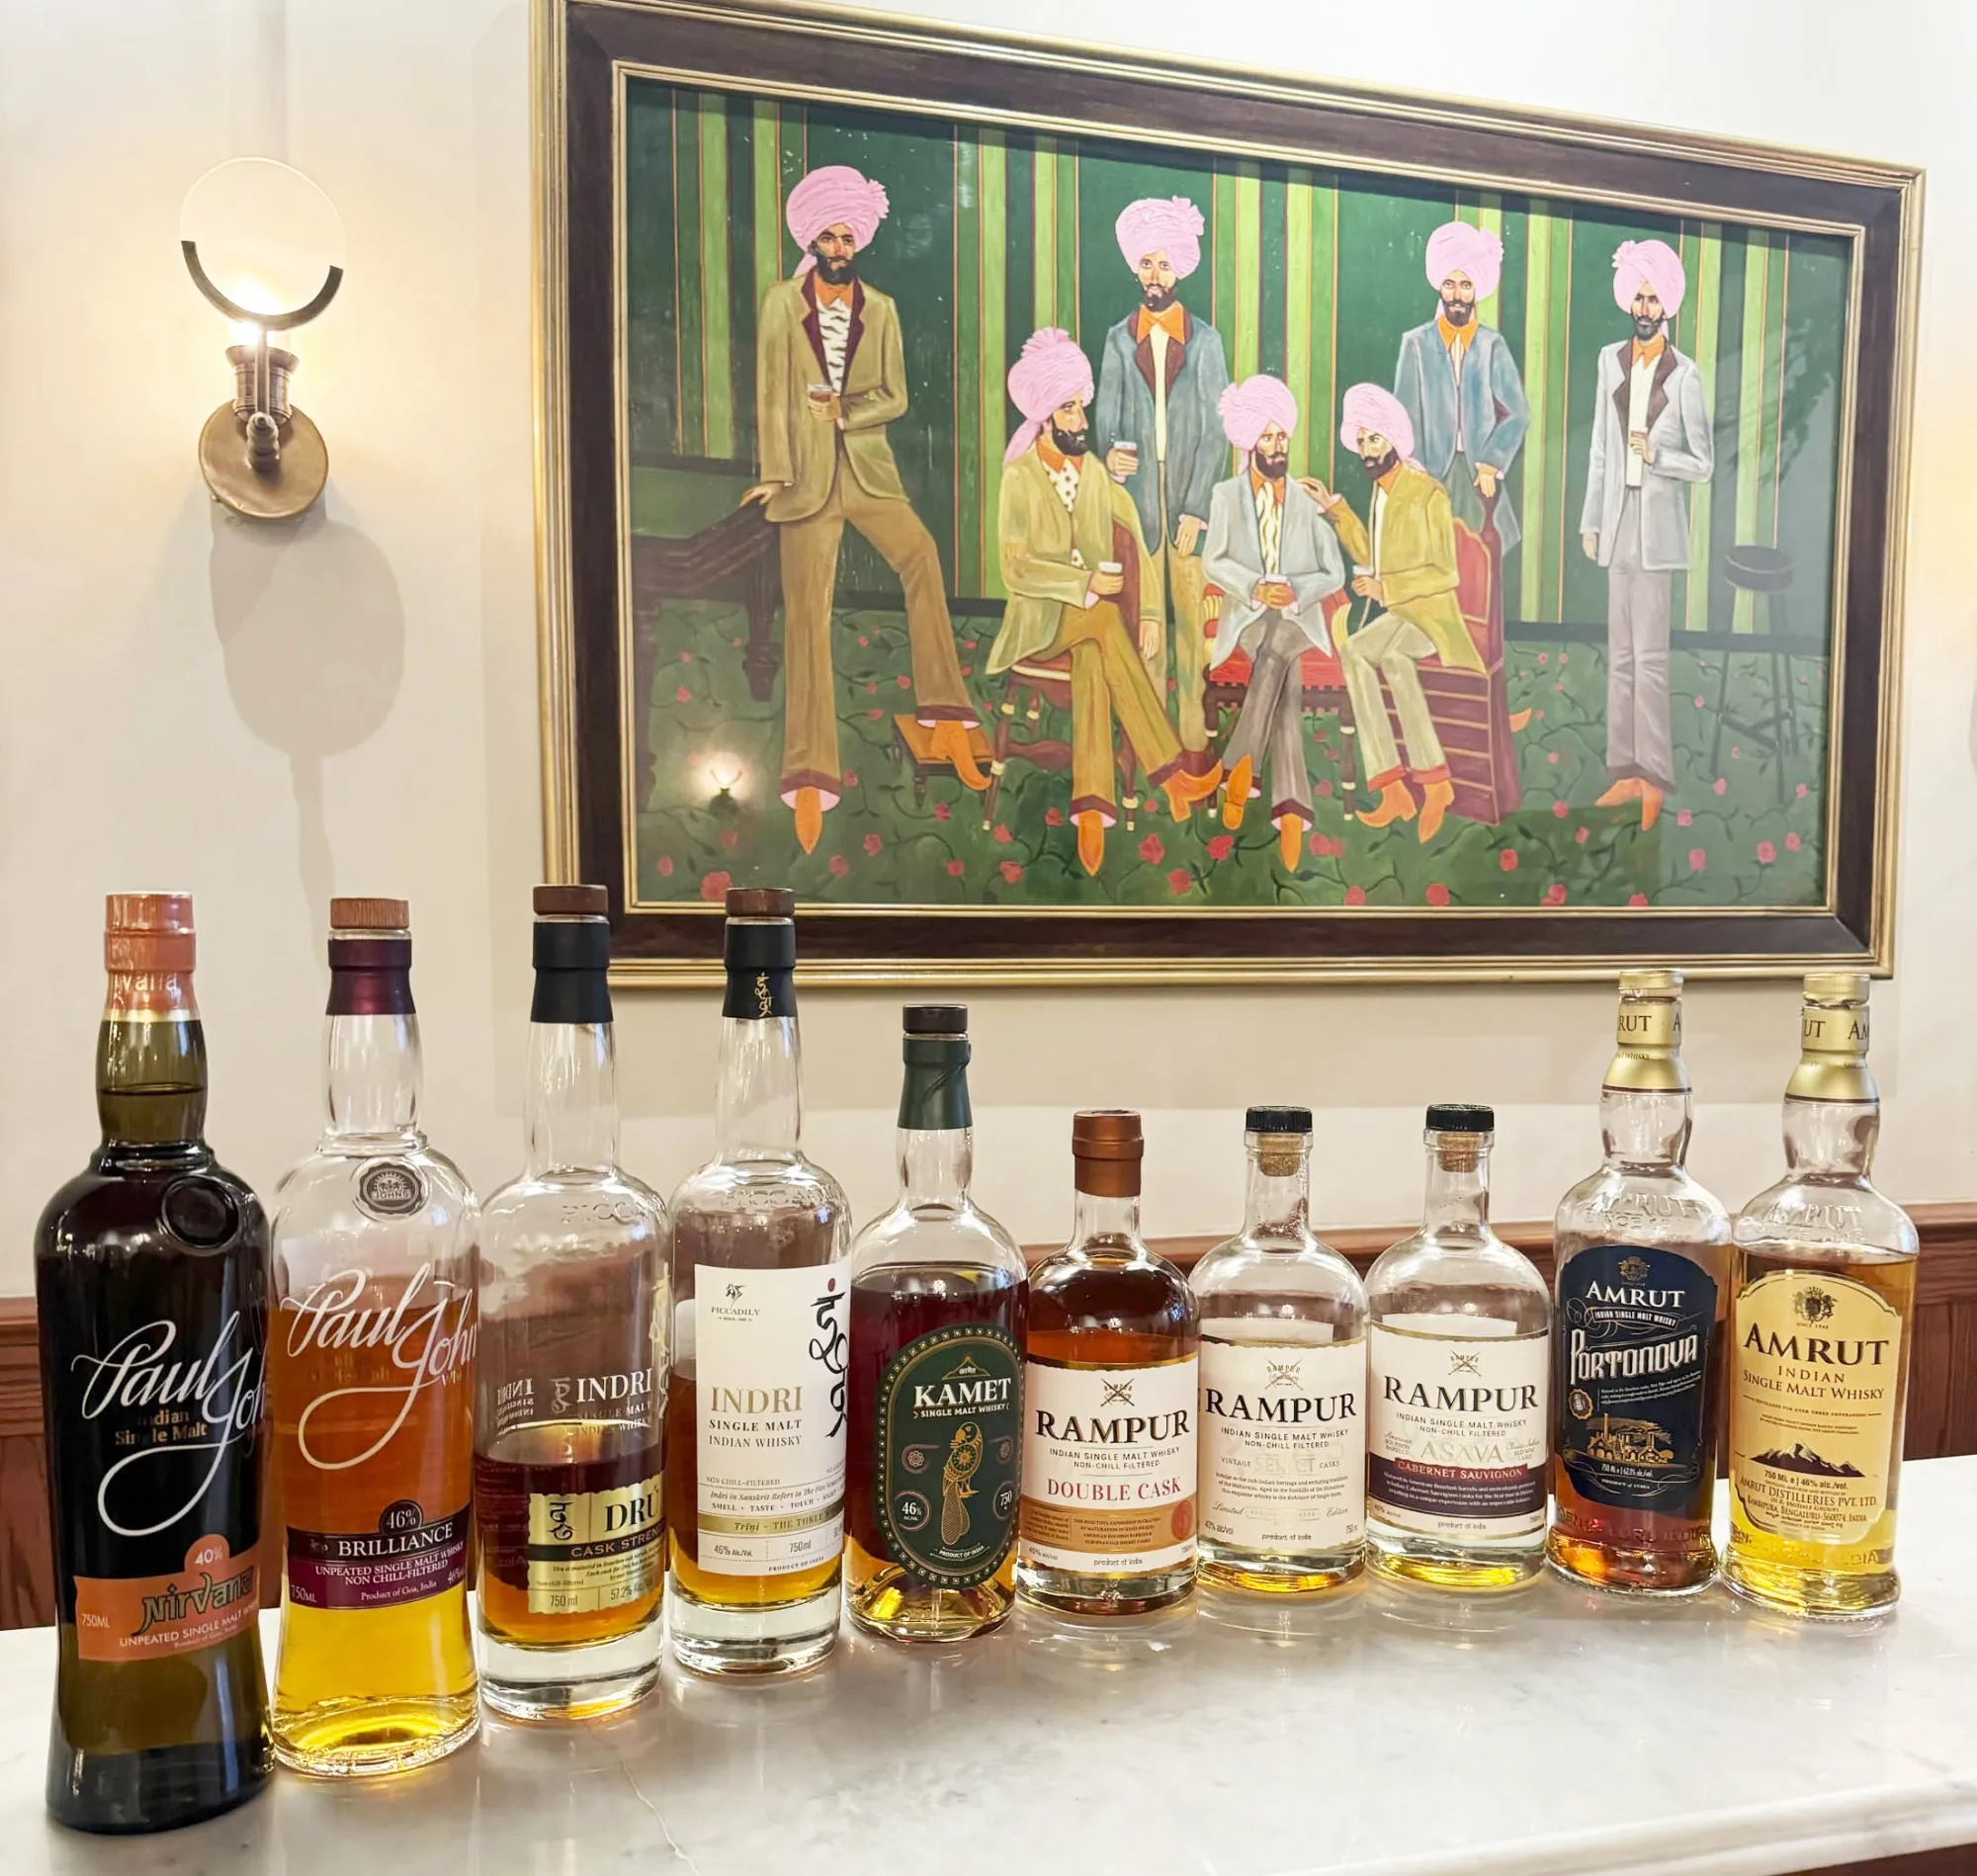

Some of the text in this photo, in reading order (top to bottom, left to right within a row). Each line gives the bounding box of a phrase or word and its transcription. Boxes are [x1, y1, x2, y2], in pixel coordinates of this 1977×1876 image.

[1586, 1280, 1685, 1308] AMRUT
[280, 1261, 431, 1358] Paul
[712, 1306, 760, 1316] PICCADILY
[1594, 1310, 1676, 1327] INDIAN SINGLE MALT WHISKY
[1743, 1322, 1890, 1366] AMRUT
[70, 1310, 240, 1419] Paul
[1778, 1365, 1846, 1384] INDIAN
[576, 1368, 653, 1403] INDRI
[913, 1378, 1011, 1408] KAMET
[1384, 1375, 1538, 1412] RAMPUR
[711, 1386, 804, 1414] INDRI
[1205, 1388, 1357, 1423] RAMPUR
[920, 1404, 1005, 1418] SINGLE MALT WHISKY
[709, 1418, 803, 1432] SINGLE MALT
[1035, 1409, 1190, 1444] RAMPUR
[1396, 1412, 1425, 1423] INDIAN
[1429, 1418, 1464, 1427] SINGLE
[1497, 1419, 1527, 1428] WHISKY
[1221, 1426, 1348, 1441] INDIAN SINGLE MALT WHISKY
[1419, 1426, 1465, 1436] NON-CHILL
[709, 1435, 803, 1448] INDIAN WHISKY
[1245, 1439, 1289, 1450] NON-CHILL
[1050, 1446, 1180, 1461] INDIAN SINGLE MALT WHISKY
[1074, 1459, 1160, 1470] NON-CHILL FILTERED
[1220, 1456, 1251, 1468] VINTAGE
[1254, 1456, 1317, 1474] SELCT
[1398, 1461, 1522, 1481] CABERNET SAUVIGNON
[1764, 1470, 1776, 1480] 750
[1777, 1473, 1788, 1483] ML
[711, 1491, 728, 1499] Indri
[1048, 1476, 1181, 1501] DOUBLE CASK
[1740, 1476, 1765, 1493] AMRUT
[1768, 1486, 1835, 1506] DISTILLERIES
[1838, 1496, 1857, 1507] PVT.
[712, 1502, 737, 1511] SMELL
[791, 1497, 814, 1509] TOUCH
[902, 1501, 922, 1515] 46%
[1212, 1501, 1245, 1515] Limited
[386, 1508, 417, 1531] 46%
[1848, 1513, 1867, 1522] INDIA
[338, 1522, 454, 1557] BRILLIANCE
[790, 1540, 812, 1553] 750ml
[195, 1546, 223, 1566] 40%
[570, 1542, 615, 1558] CASK
[714, 1545, 731, 1556] 46%
[315, 1564, 373, 1578] UNPEATED
[374, 1560, 412, 1575] SINGLE
[414, 1554, 440, 1569] MALT
[345, 1559, 449, 1586] NON CHILL-FILTERED
[768, 1563, 799, 1573] PRODUCT
[130, 1566, 254, 1637] Nirvana
[361, 1589, 391, 1601] Product
[392, 1588, 402, 1598] of
[550, 1594, 578, 1607] 750 ml
[81, 1613, 112, 1629] 750ML
[120, 1632, 180, 1648] UNPEATED
[182, 1619, 219, 1639] SINGLE
